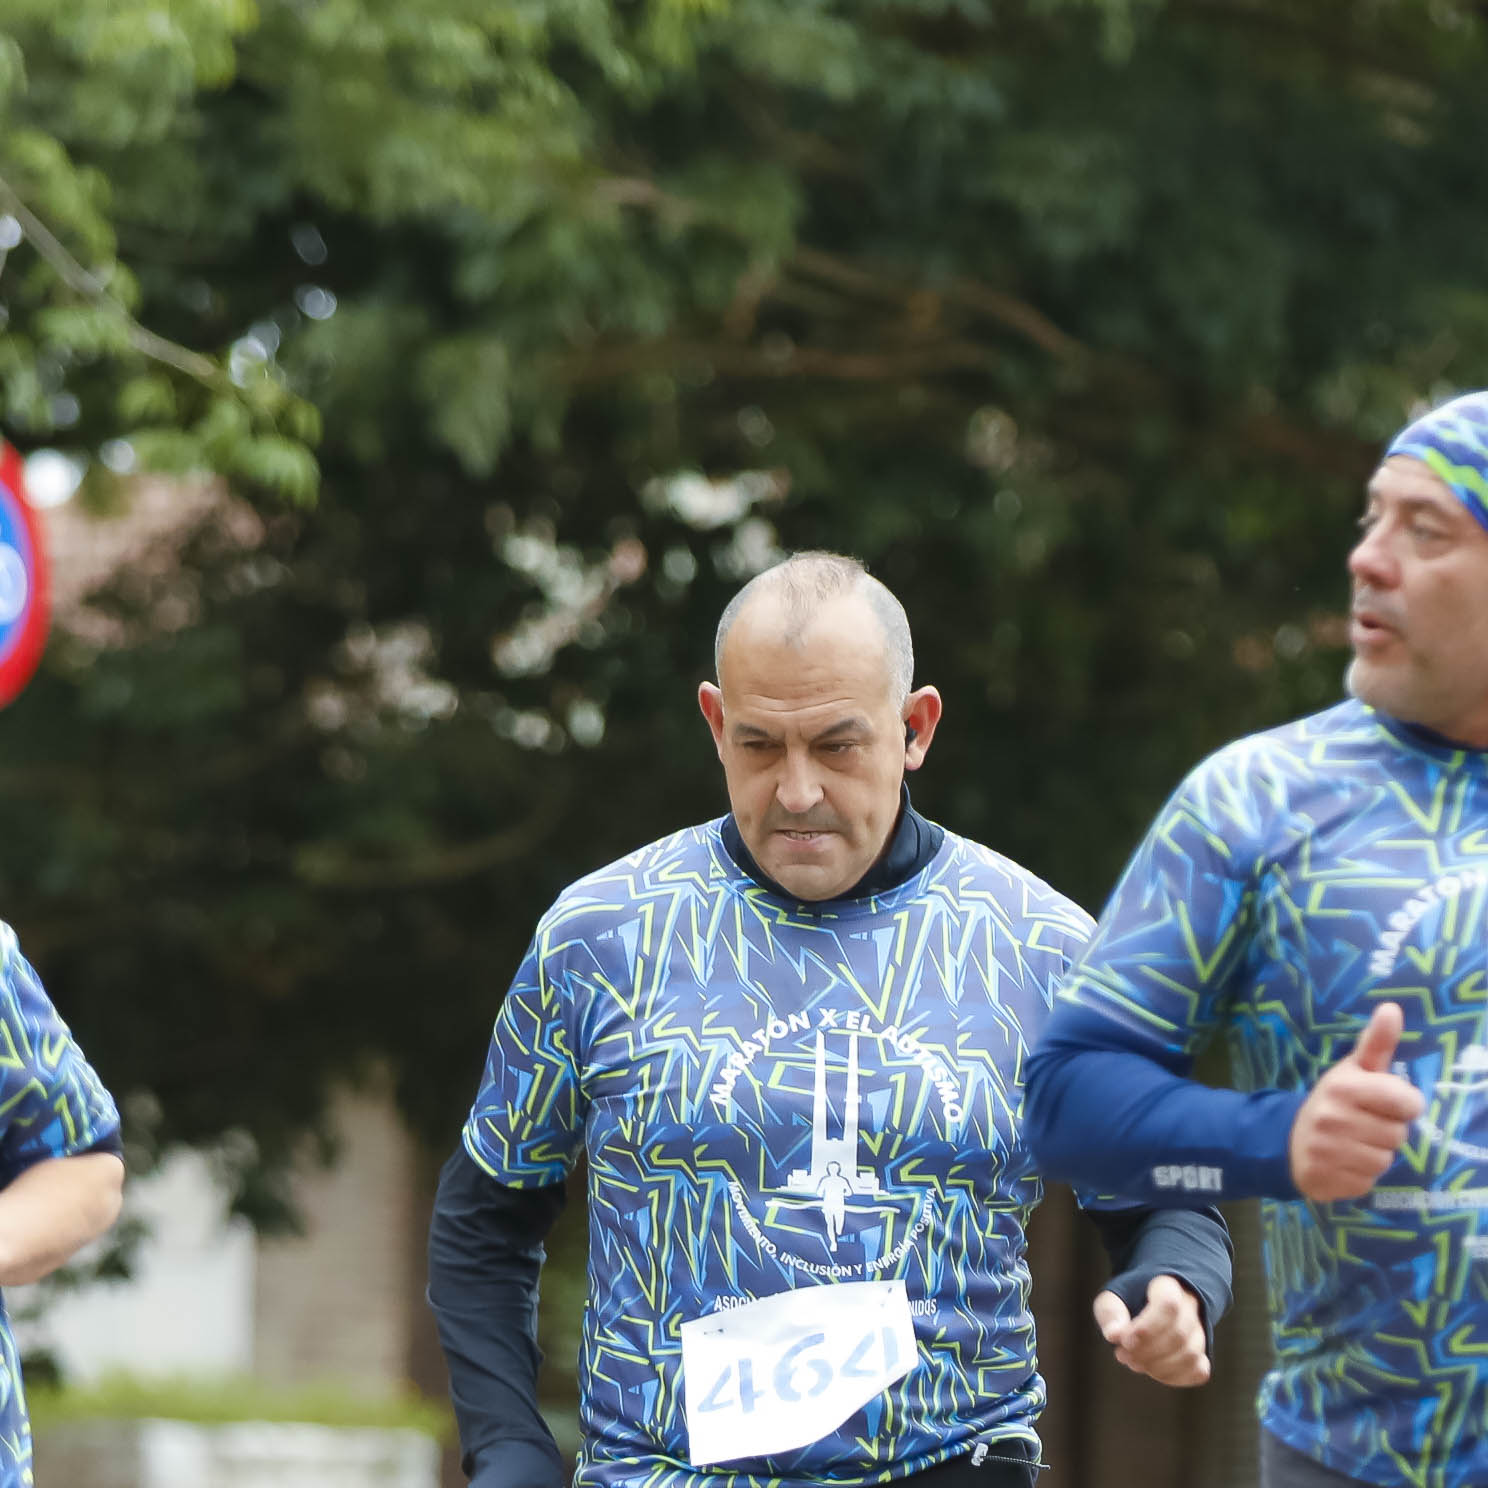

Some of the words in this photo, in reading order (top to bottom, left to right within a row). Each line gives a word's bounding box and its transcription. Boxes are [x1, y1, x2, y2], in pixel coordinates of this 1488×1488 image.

[819, 1007, 839, 1028] X
[846, 1010, 874, 1033] EL
[879, 1024, 964, 1123] AUTISMO
[1152, 1165, 1223, 1192] SPORT
[853, 1263, 863, 1275] Y
[910, 1187, 937, 1241] POSITIVA
[697, 1325, 901, 1414] 464
